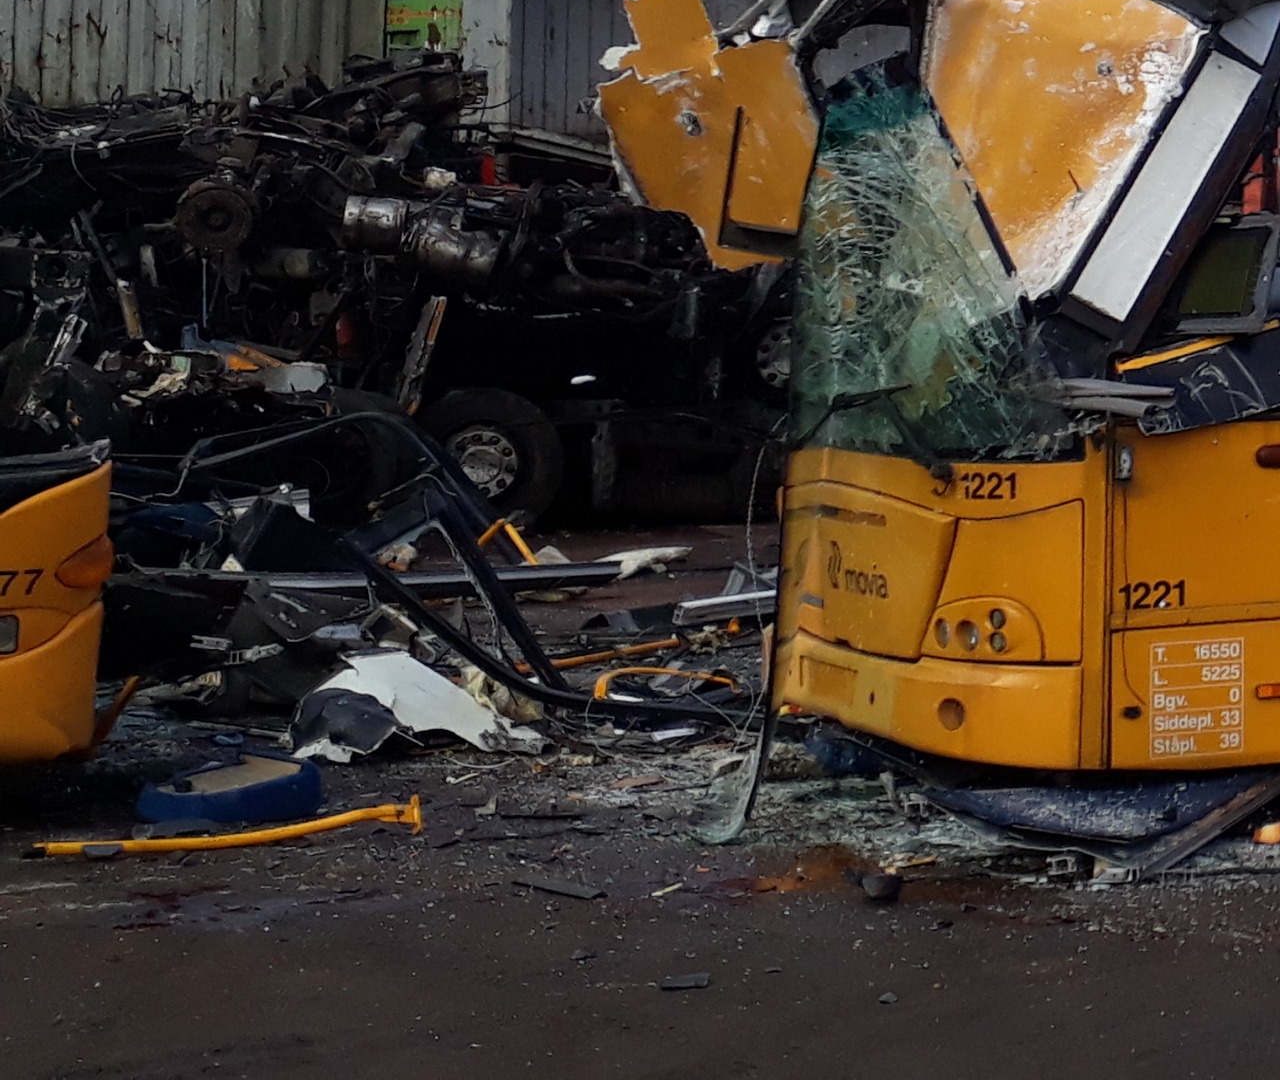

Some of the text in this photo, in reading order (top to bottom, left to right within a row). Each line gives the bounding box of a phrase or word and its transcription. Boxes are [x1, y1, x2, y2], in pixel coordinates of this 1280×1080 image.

[960, 472, 1017, 500] 1221
[844, 564, 889, 599] movia
[1118, 579, 1186, 610] 1221
[1154, 643, 1240, 662] T. 16550
[1154, 665, 1240, 686] L. 5225
[1154, 687, 1240, 712] Bgv. 0
[1154, 710, 1240, 732] Siddepl. 33
[1154, 733, 1239, 755] Ståpl. 39
